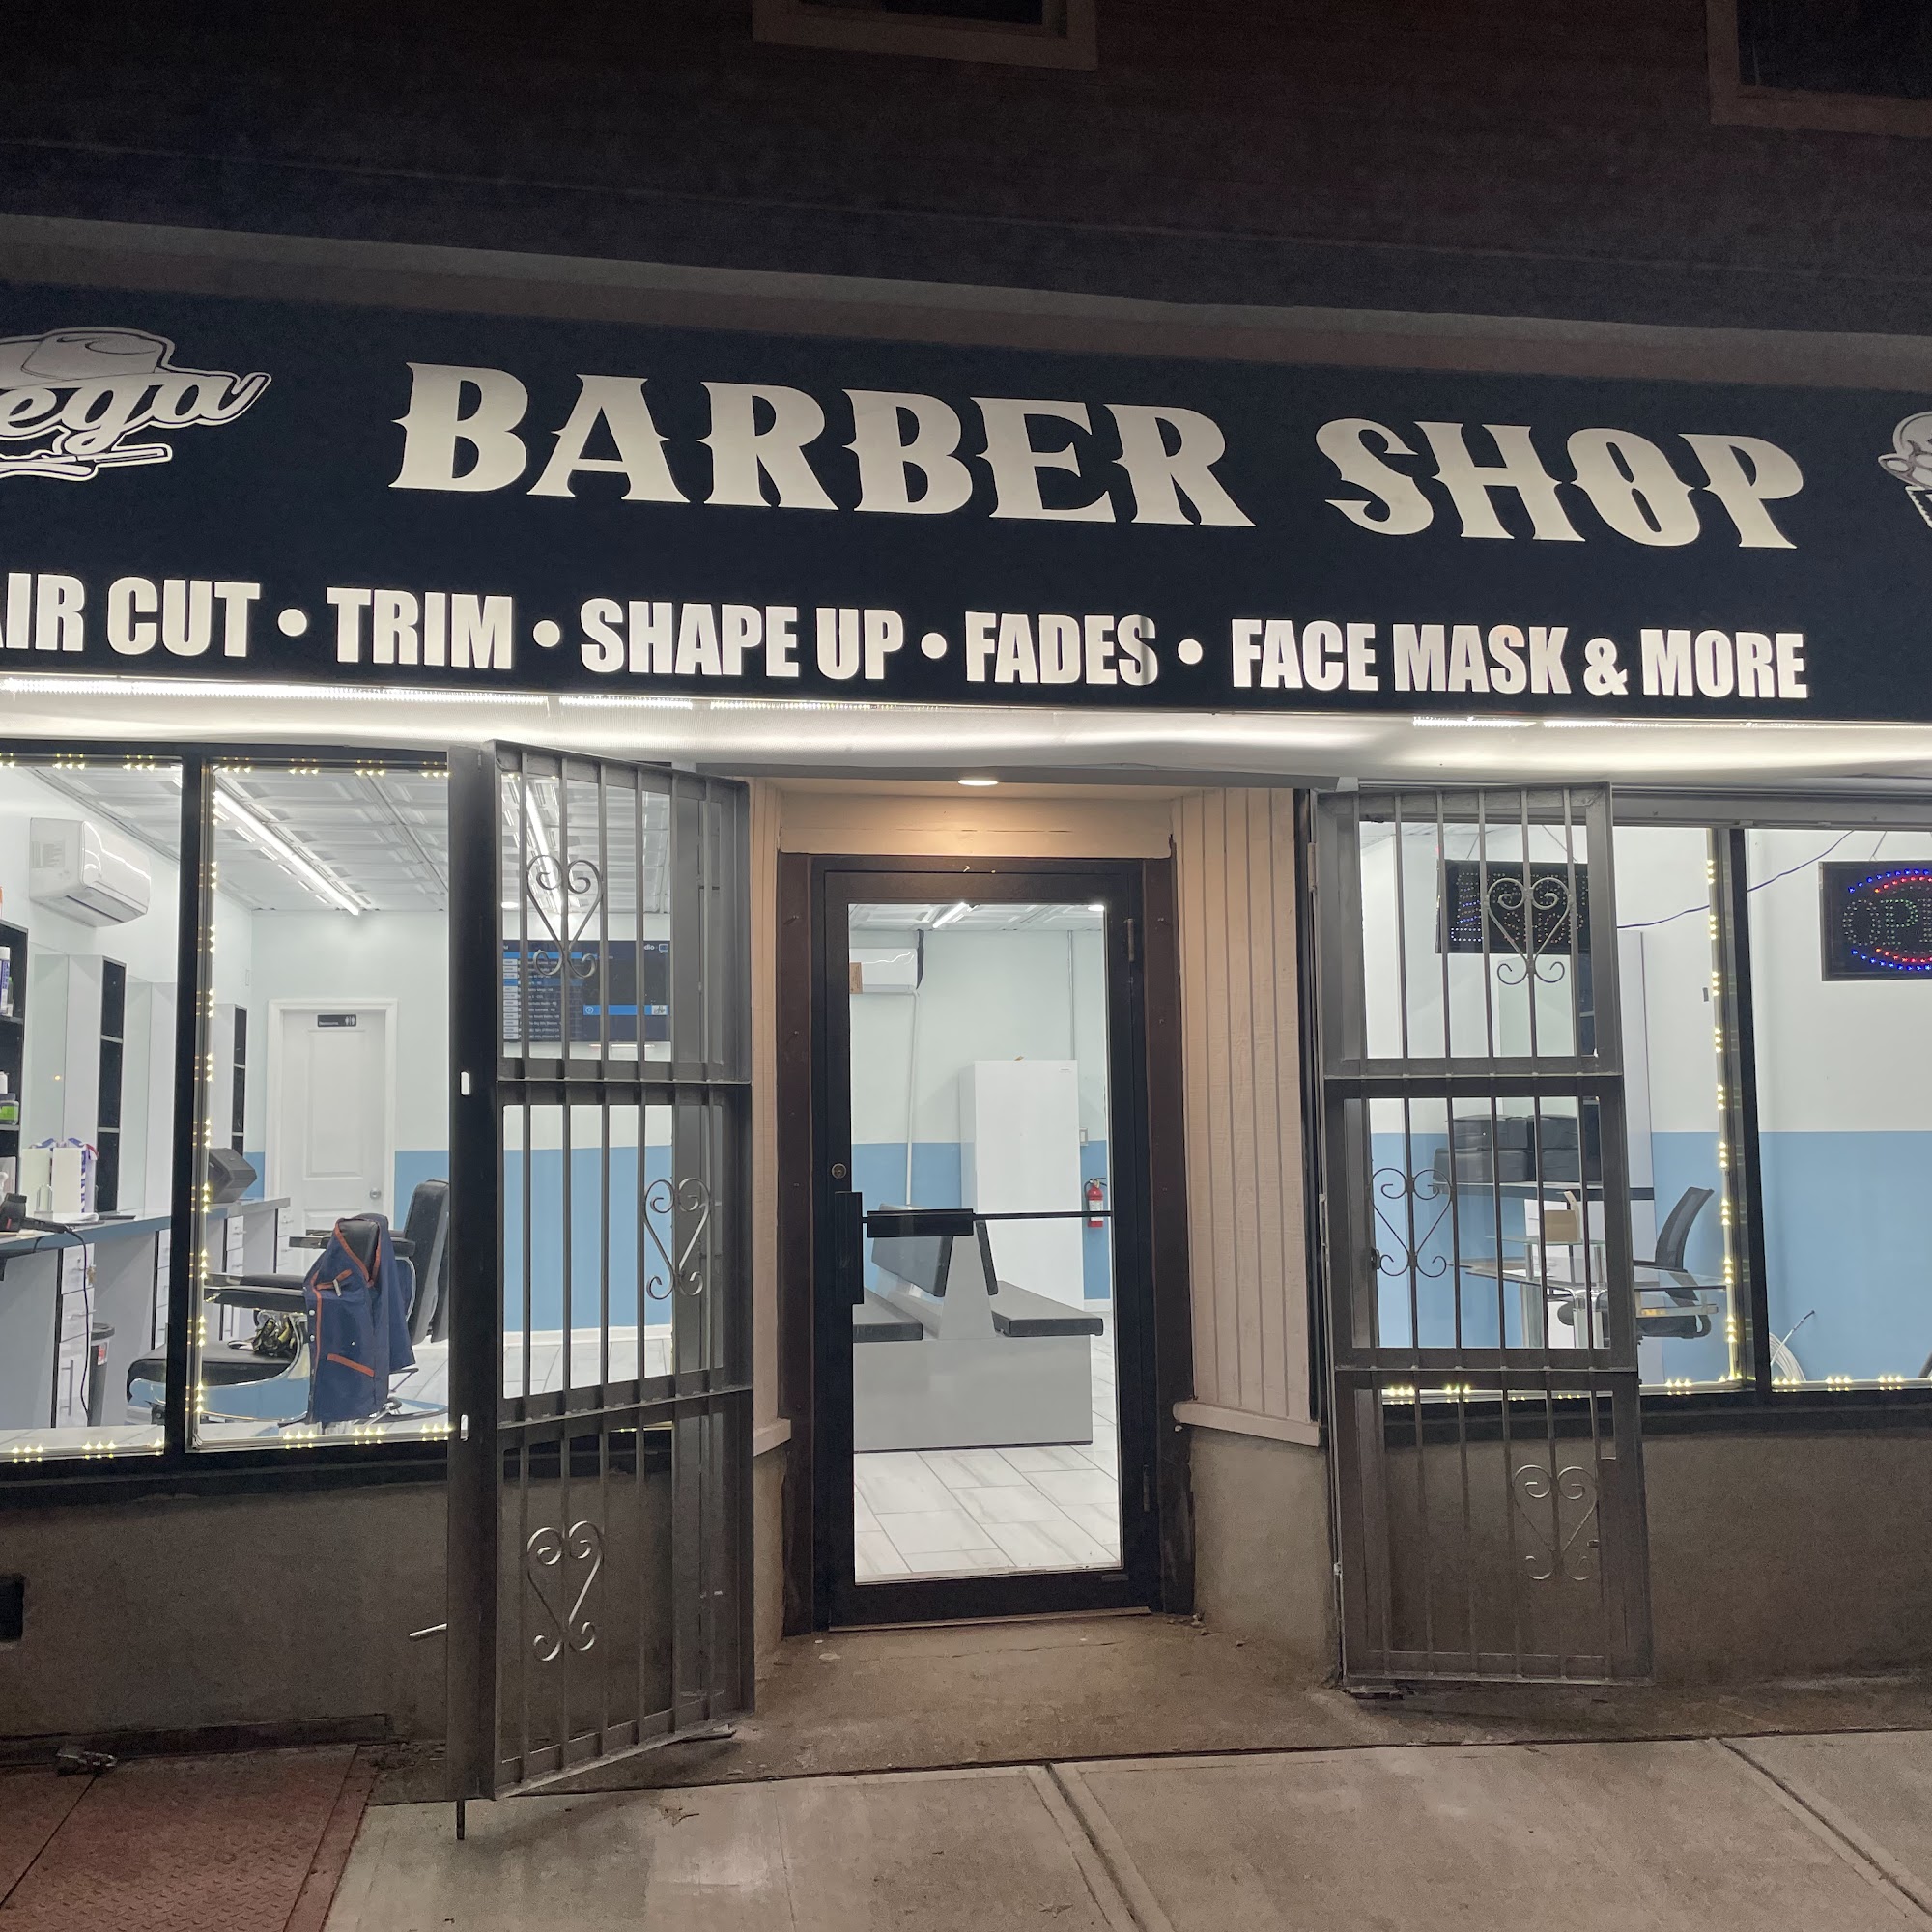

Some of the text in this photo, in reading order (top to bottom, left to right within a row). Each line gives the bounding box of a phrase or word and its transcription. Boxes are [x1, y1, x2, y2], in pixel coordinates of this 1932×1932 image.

[388, 363, 1803, 549] BARBER SHOP
[0, 573, 1808, 698] IR CUT TRIM SHAPE UP FADES FACE MASK & MORE
[1488, 873, 1589, 905] BARB
